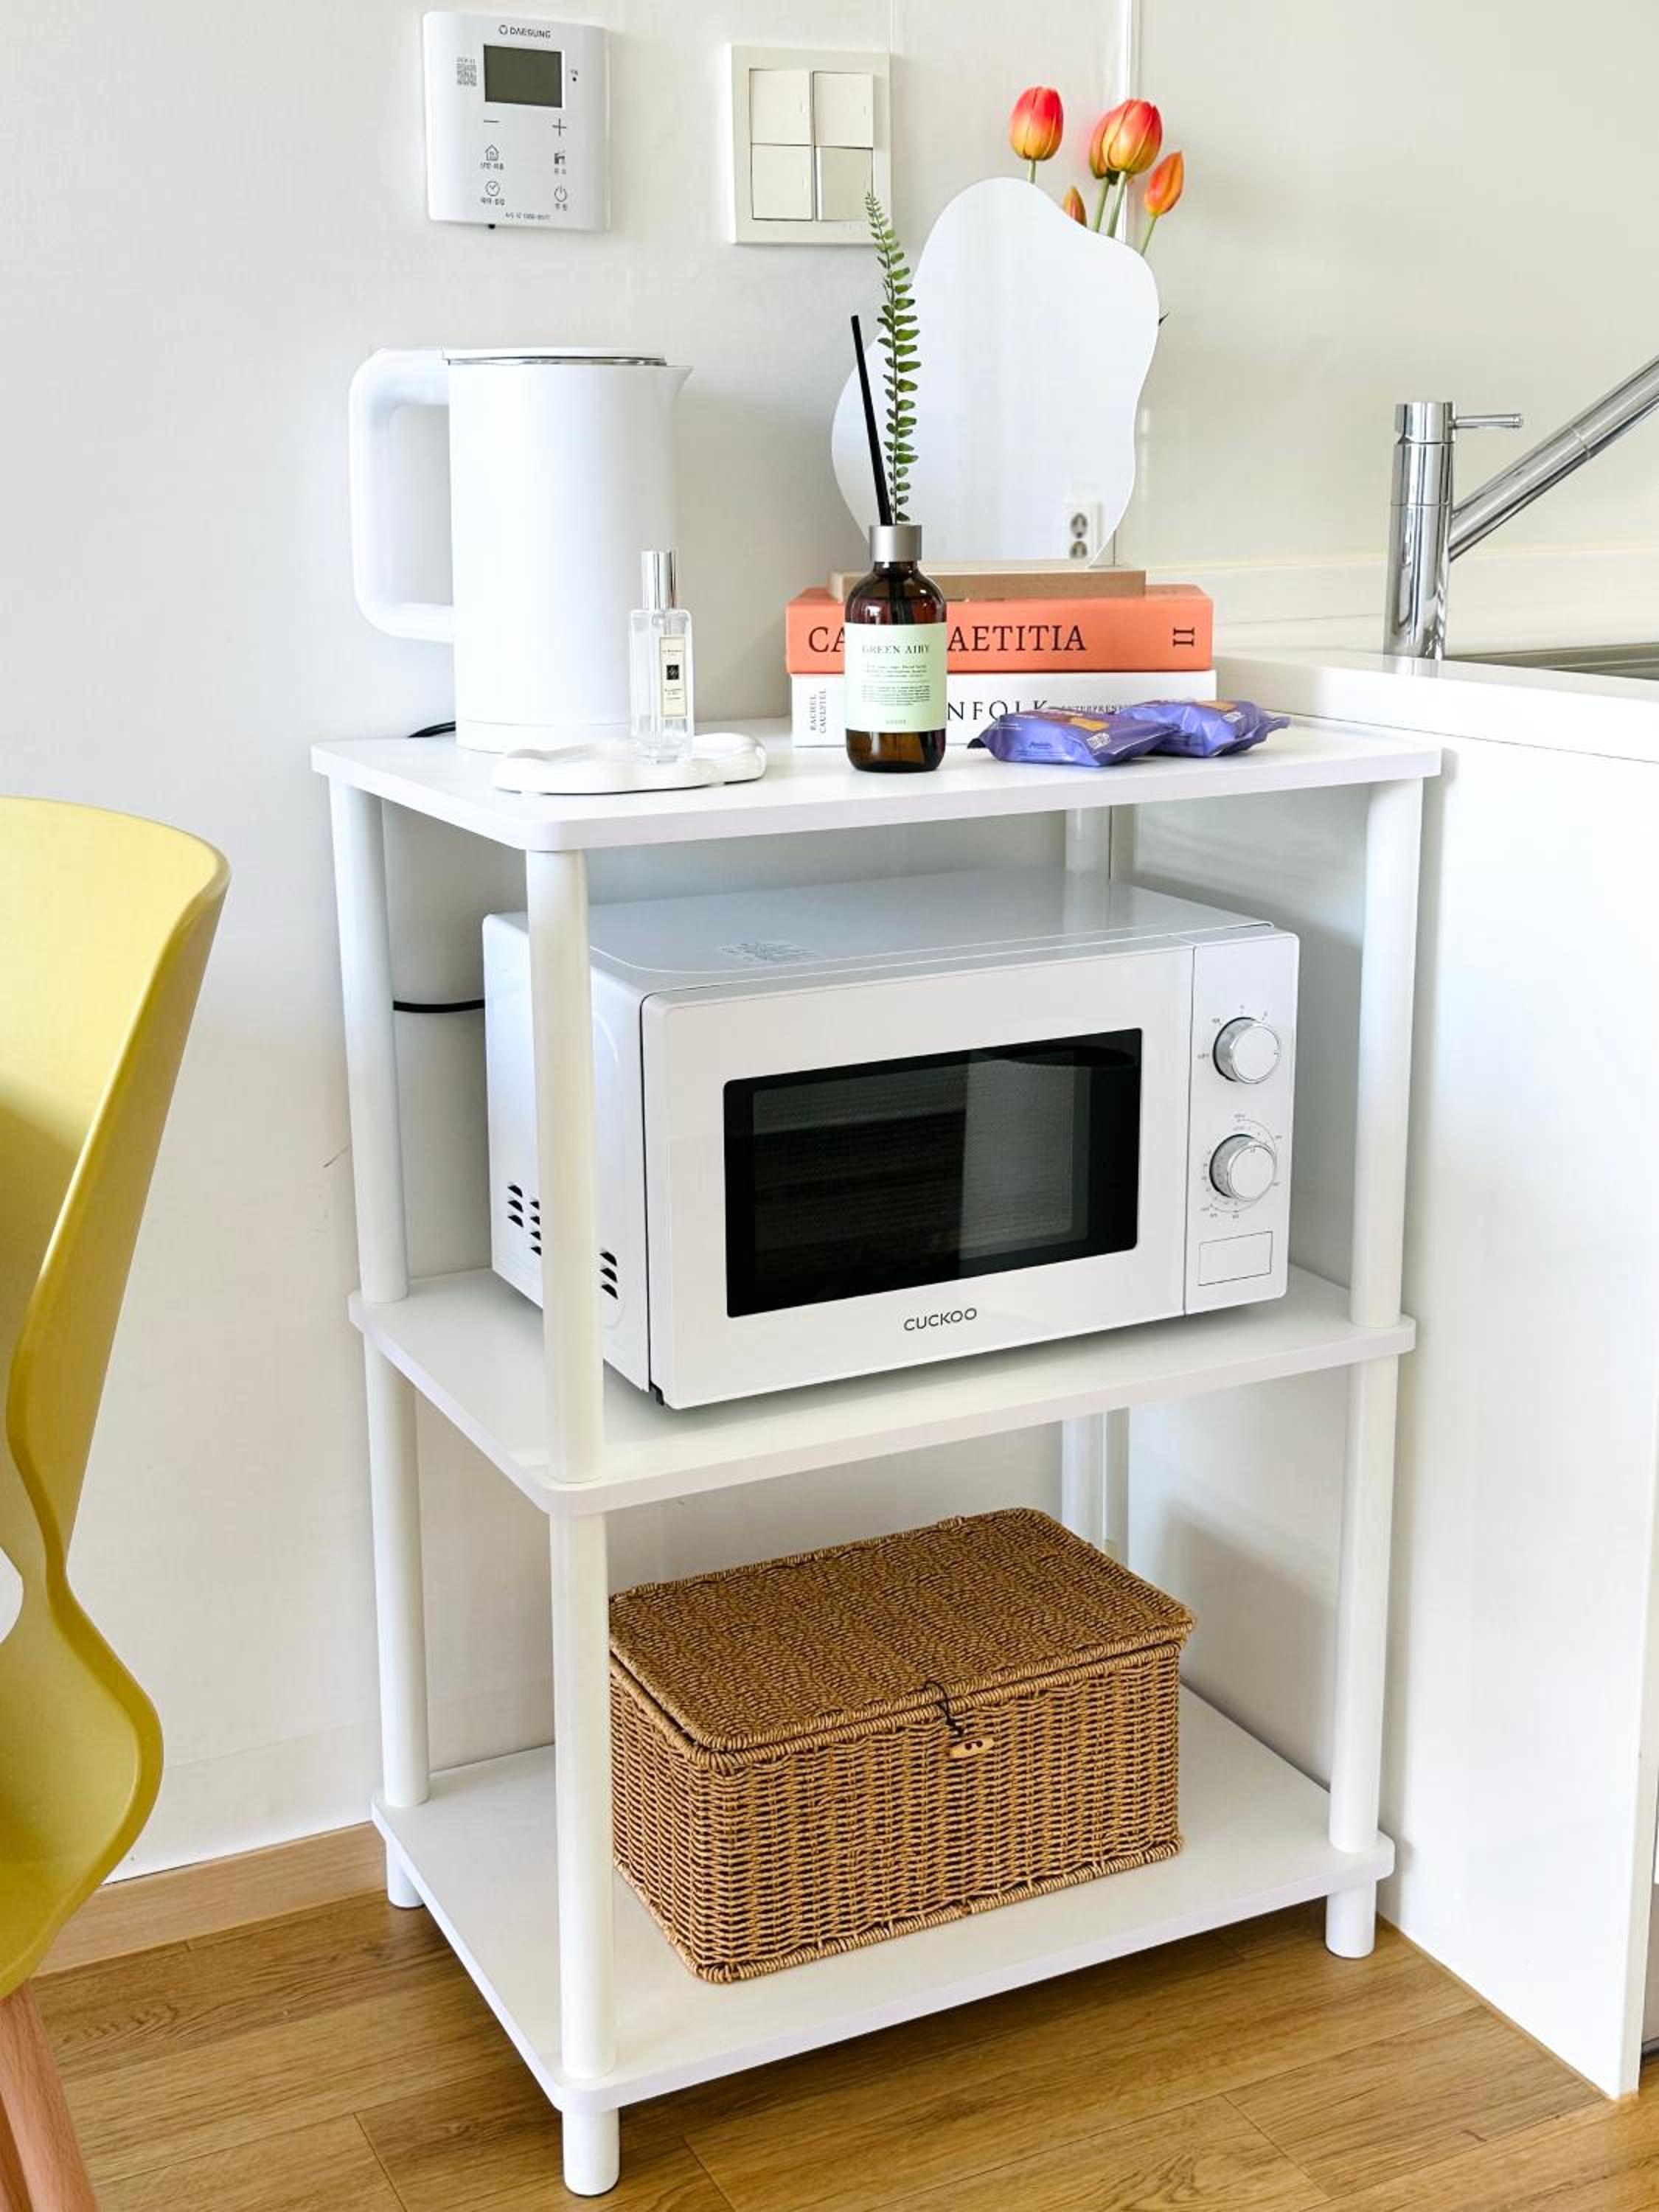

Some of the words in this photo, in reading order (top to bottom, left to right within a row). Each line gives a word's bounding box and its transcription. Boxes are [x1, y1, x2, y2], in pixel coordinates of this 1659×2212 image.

[509, 27, 552, 38] DAESUNG
[947, 625, 1087, 651] AETITIA
[862, 644, 900, 654] GREEN
[903, 1307, 977, 1331] CUCKOO
